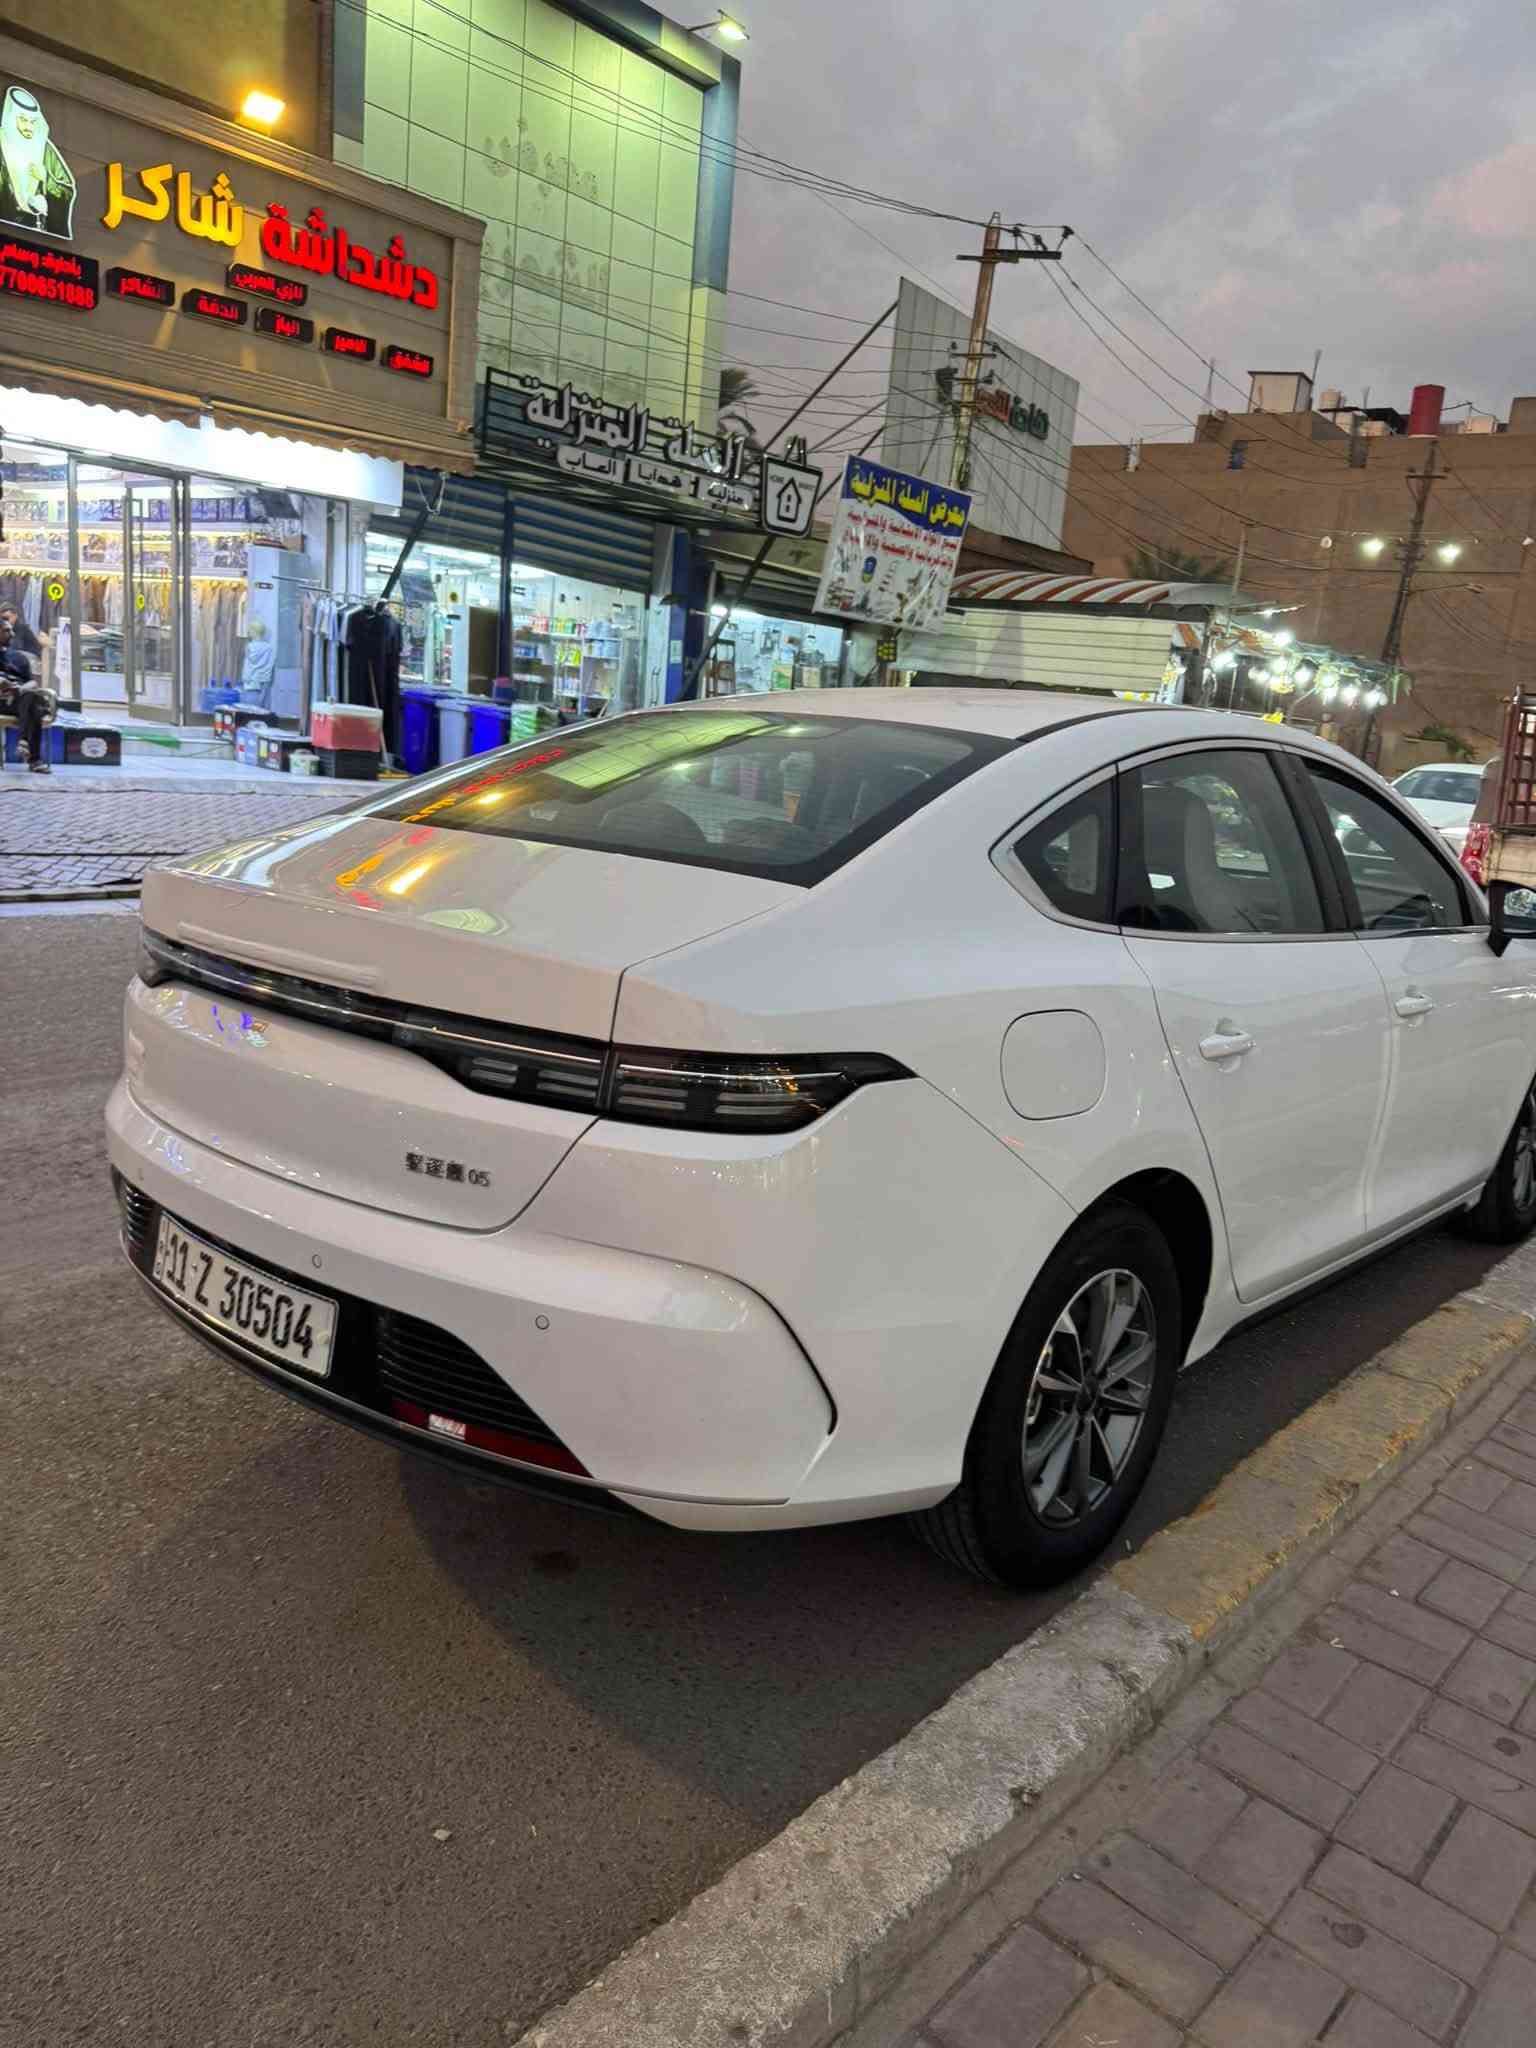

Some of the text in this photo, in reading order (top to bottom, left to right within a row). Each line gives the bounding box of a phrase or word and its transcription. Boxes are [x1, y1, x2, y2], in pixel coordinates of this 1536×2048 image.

[102, 162, 244, 247] شاكر
[260, 201, 439, 310] دشداشة
[523, 376, 746, 480] السلة المنزلية
[565, 453, 618, 476] العاب
[637, 463, 682, 488] هدايا
[851, 464, 966, 528] معرض السلة المنزلية
[166, 1233, 189, 1292] 11
[195, 1251, 214, 1308] Z
[219, 1265, 313, 1359] 30504
